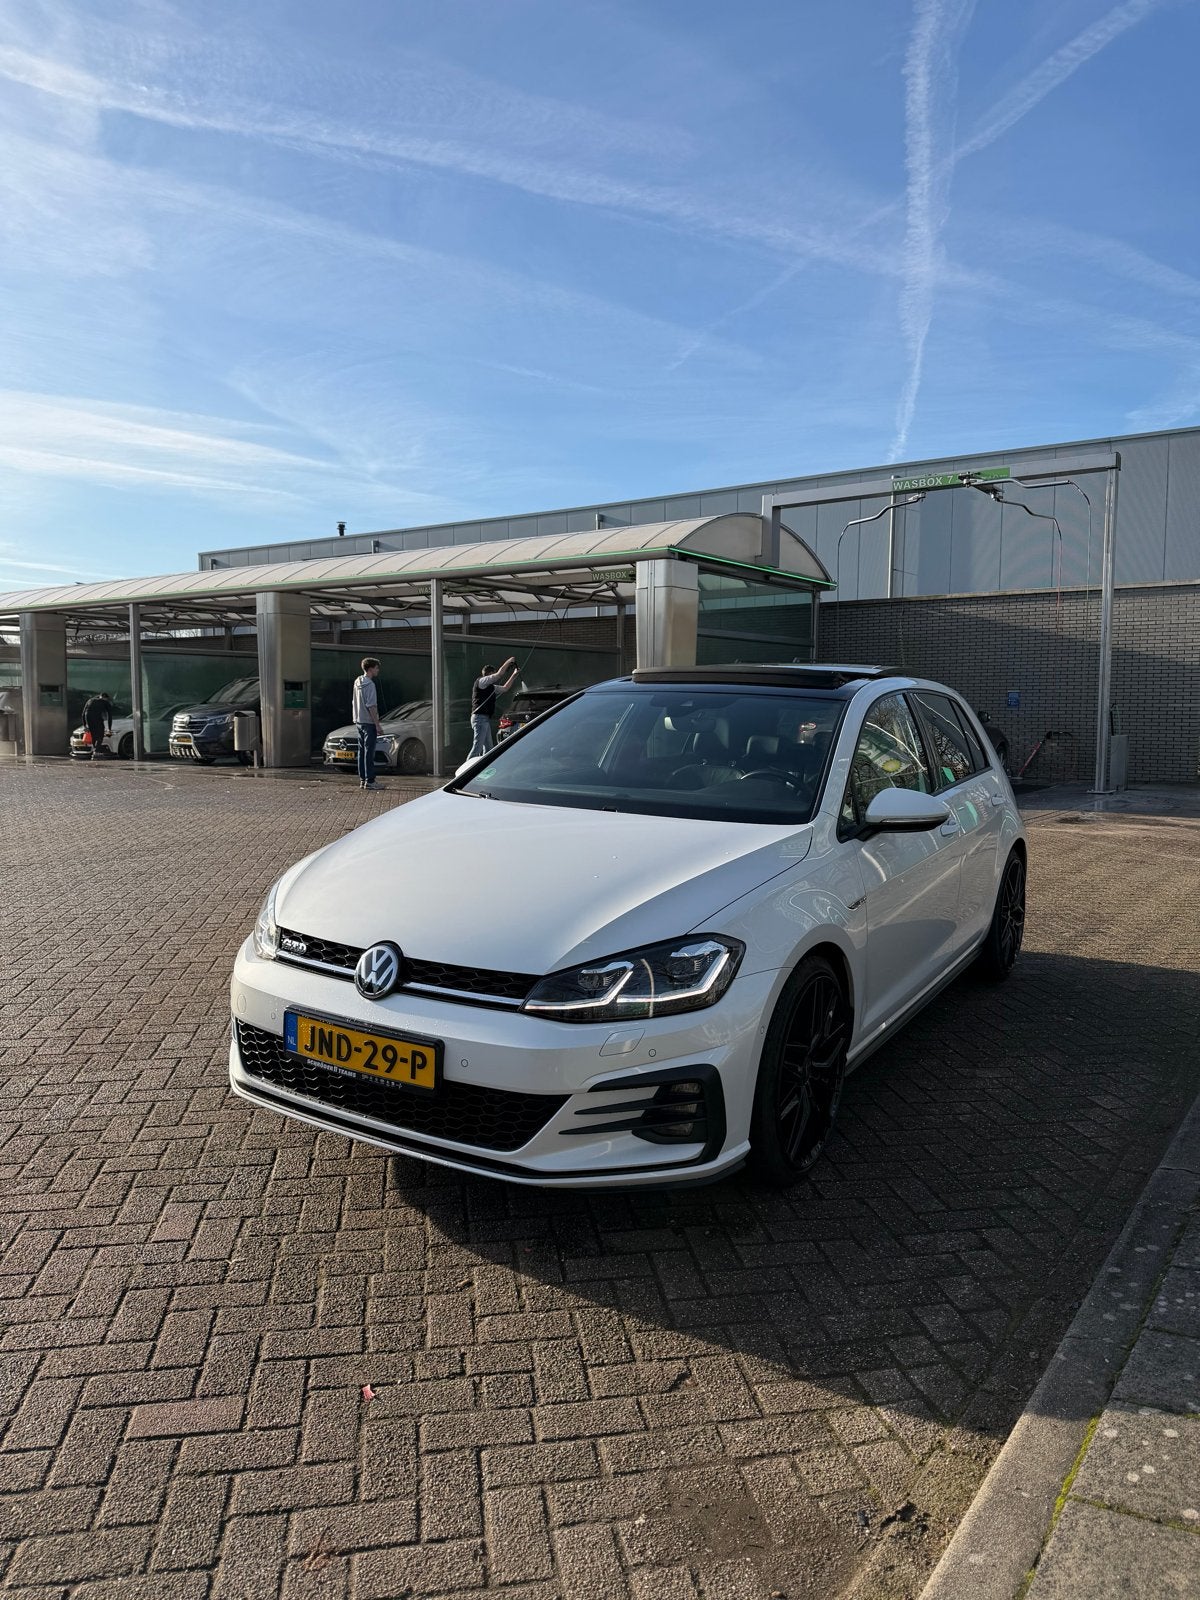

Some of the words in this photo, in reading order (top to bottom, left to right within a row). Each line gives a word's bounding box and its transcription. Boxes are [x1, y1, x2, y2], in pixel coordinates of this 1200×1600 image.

[893, 475, 943, 490] WASBOX
[947, 475, 954, 484] 7
[592, 571, 627, 580] WASBOX
[356, 945, 399, 995] VW
[287, 1035, 297, 1046] NL
[304, 1025, 428, 1080] JND-29-P
